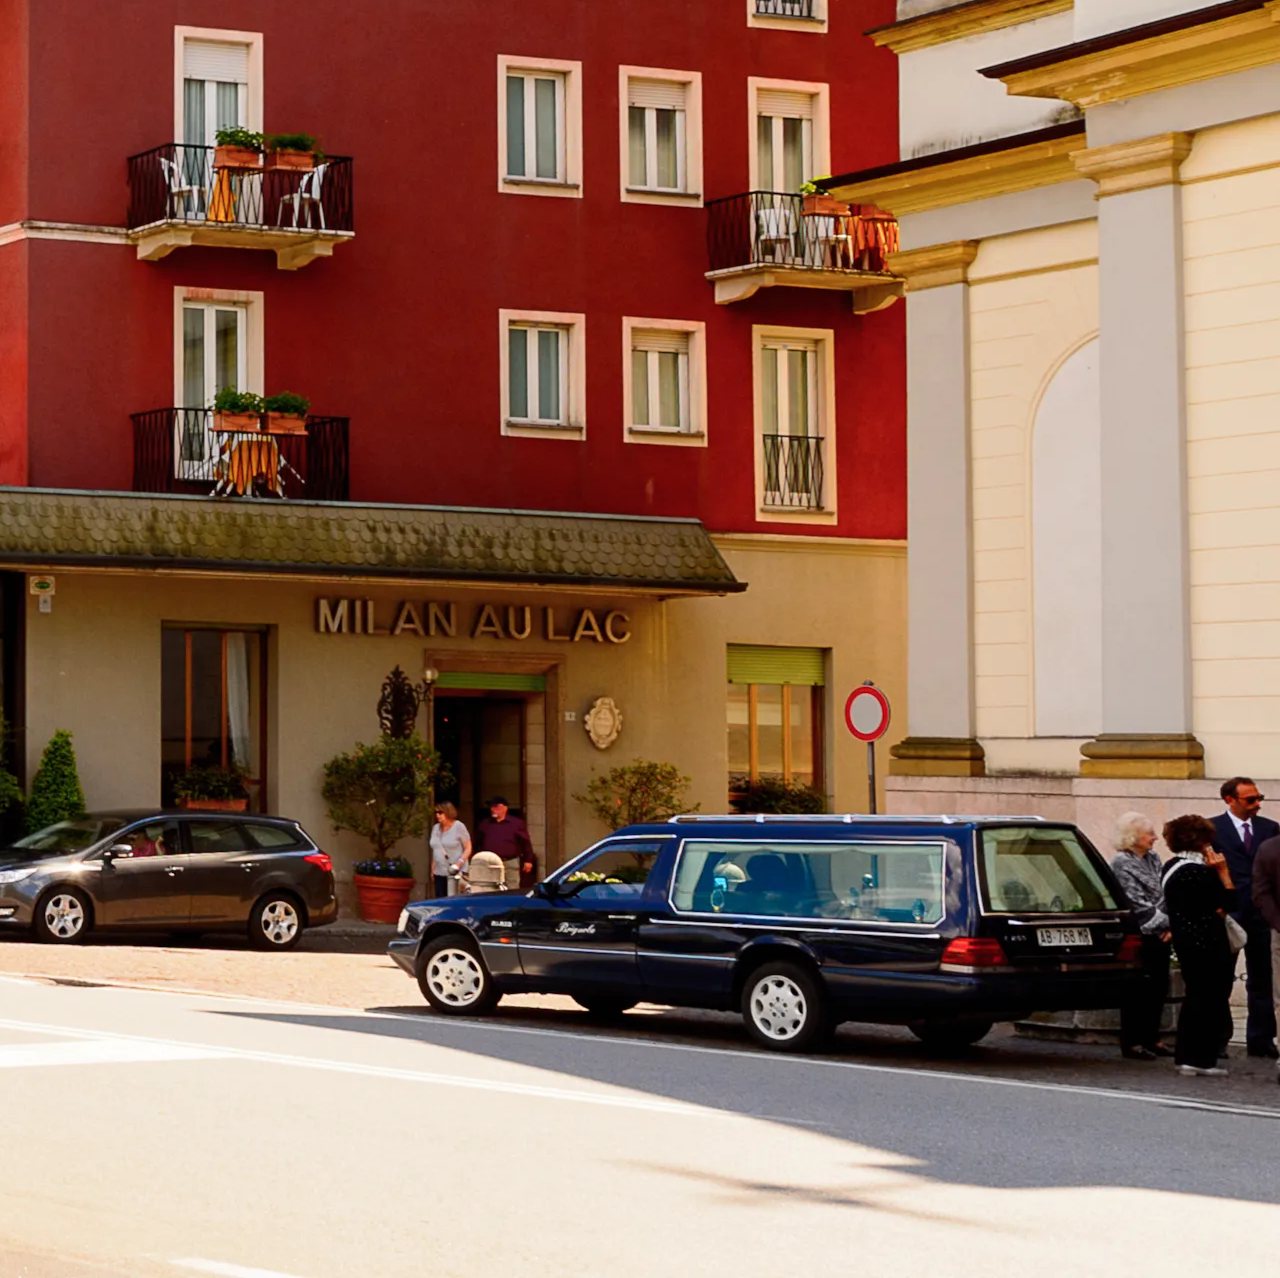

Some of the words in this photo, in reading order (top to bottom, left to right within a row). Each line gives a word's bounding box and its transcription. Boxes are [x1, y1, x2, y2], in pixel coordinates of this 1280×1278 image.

[318, 599, 457, 636] MILAN
[473, 604, 531, 640] AU
[547, 607, 632, 643] LAC
